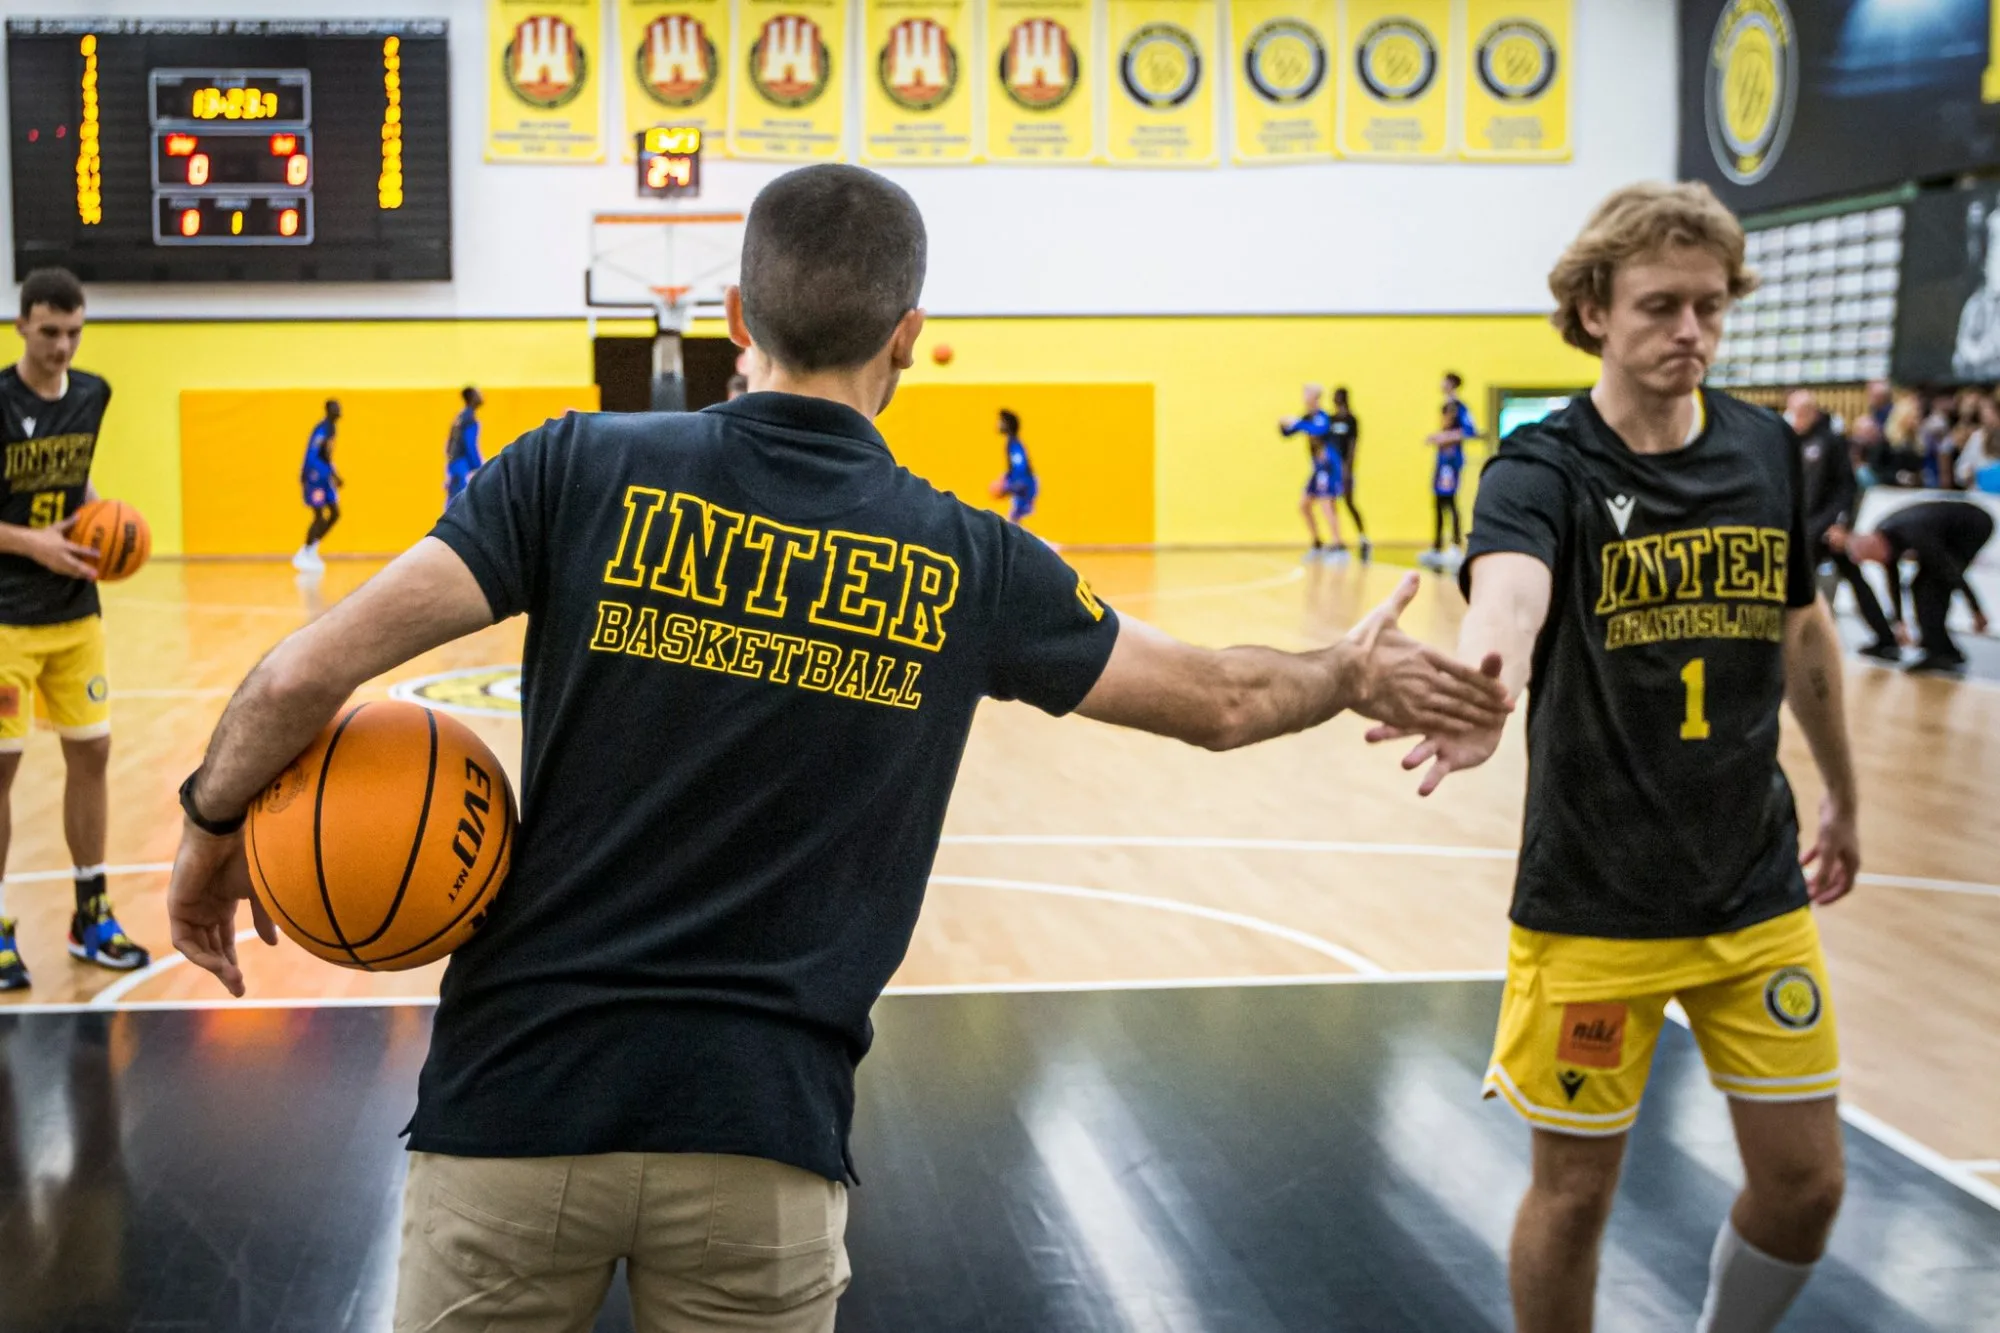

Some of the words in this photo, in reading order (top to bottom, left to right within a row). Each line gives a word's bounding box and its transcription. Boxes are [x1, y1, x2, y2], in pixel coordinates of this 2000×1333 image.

[646, 155, 692, 189] 24
[603, 484, 960, 653] INTER
[589, 600, 922, 710] BASKETBALL
[1680, 657, 1710, 740] 1
[452, 757, 491, 869] EVO
